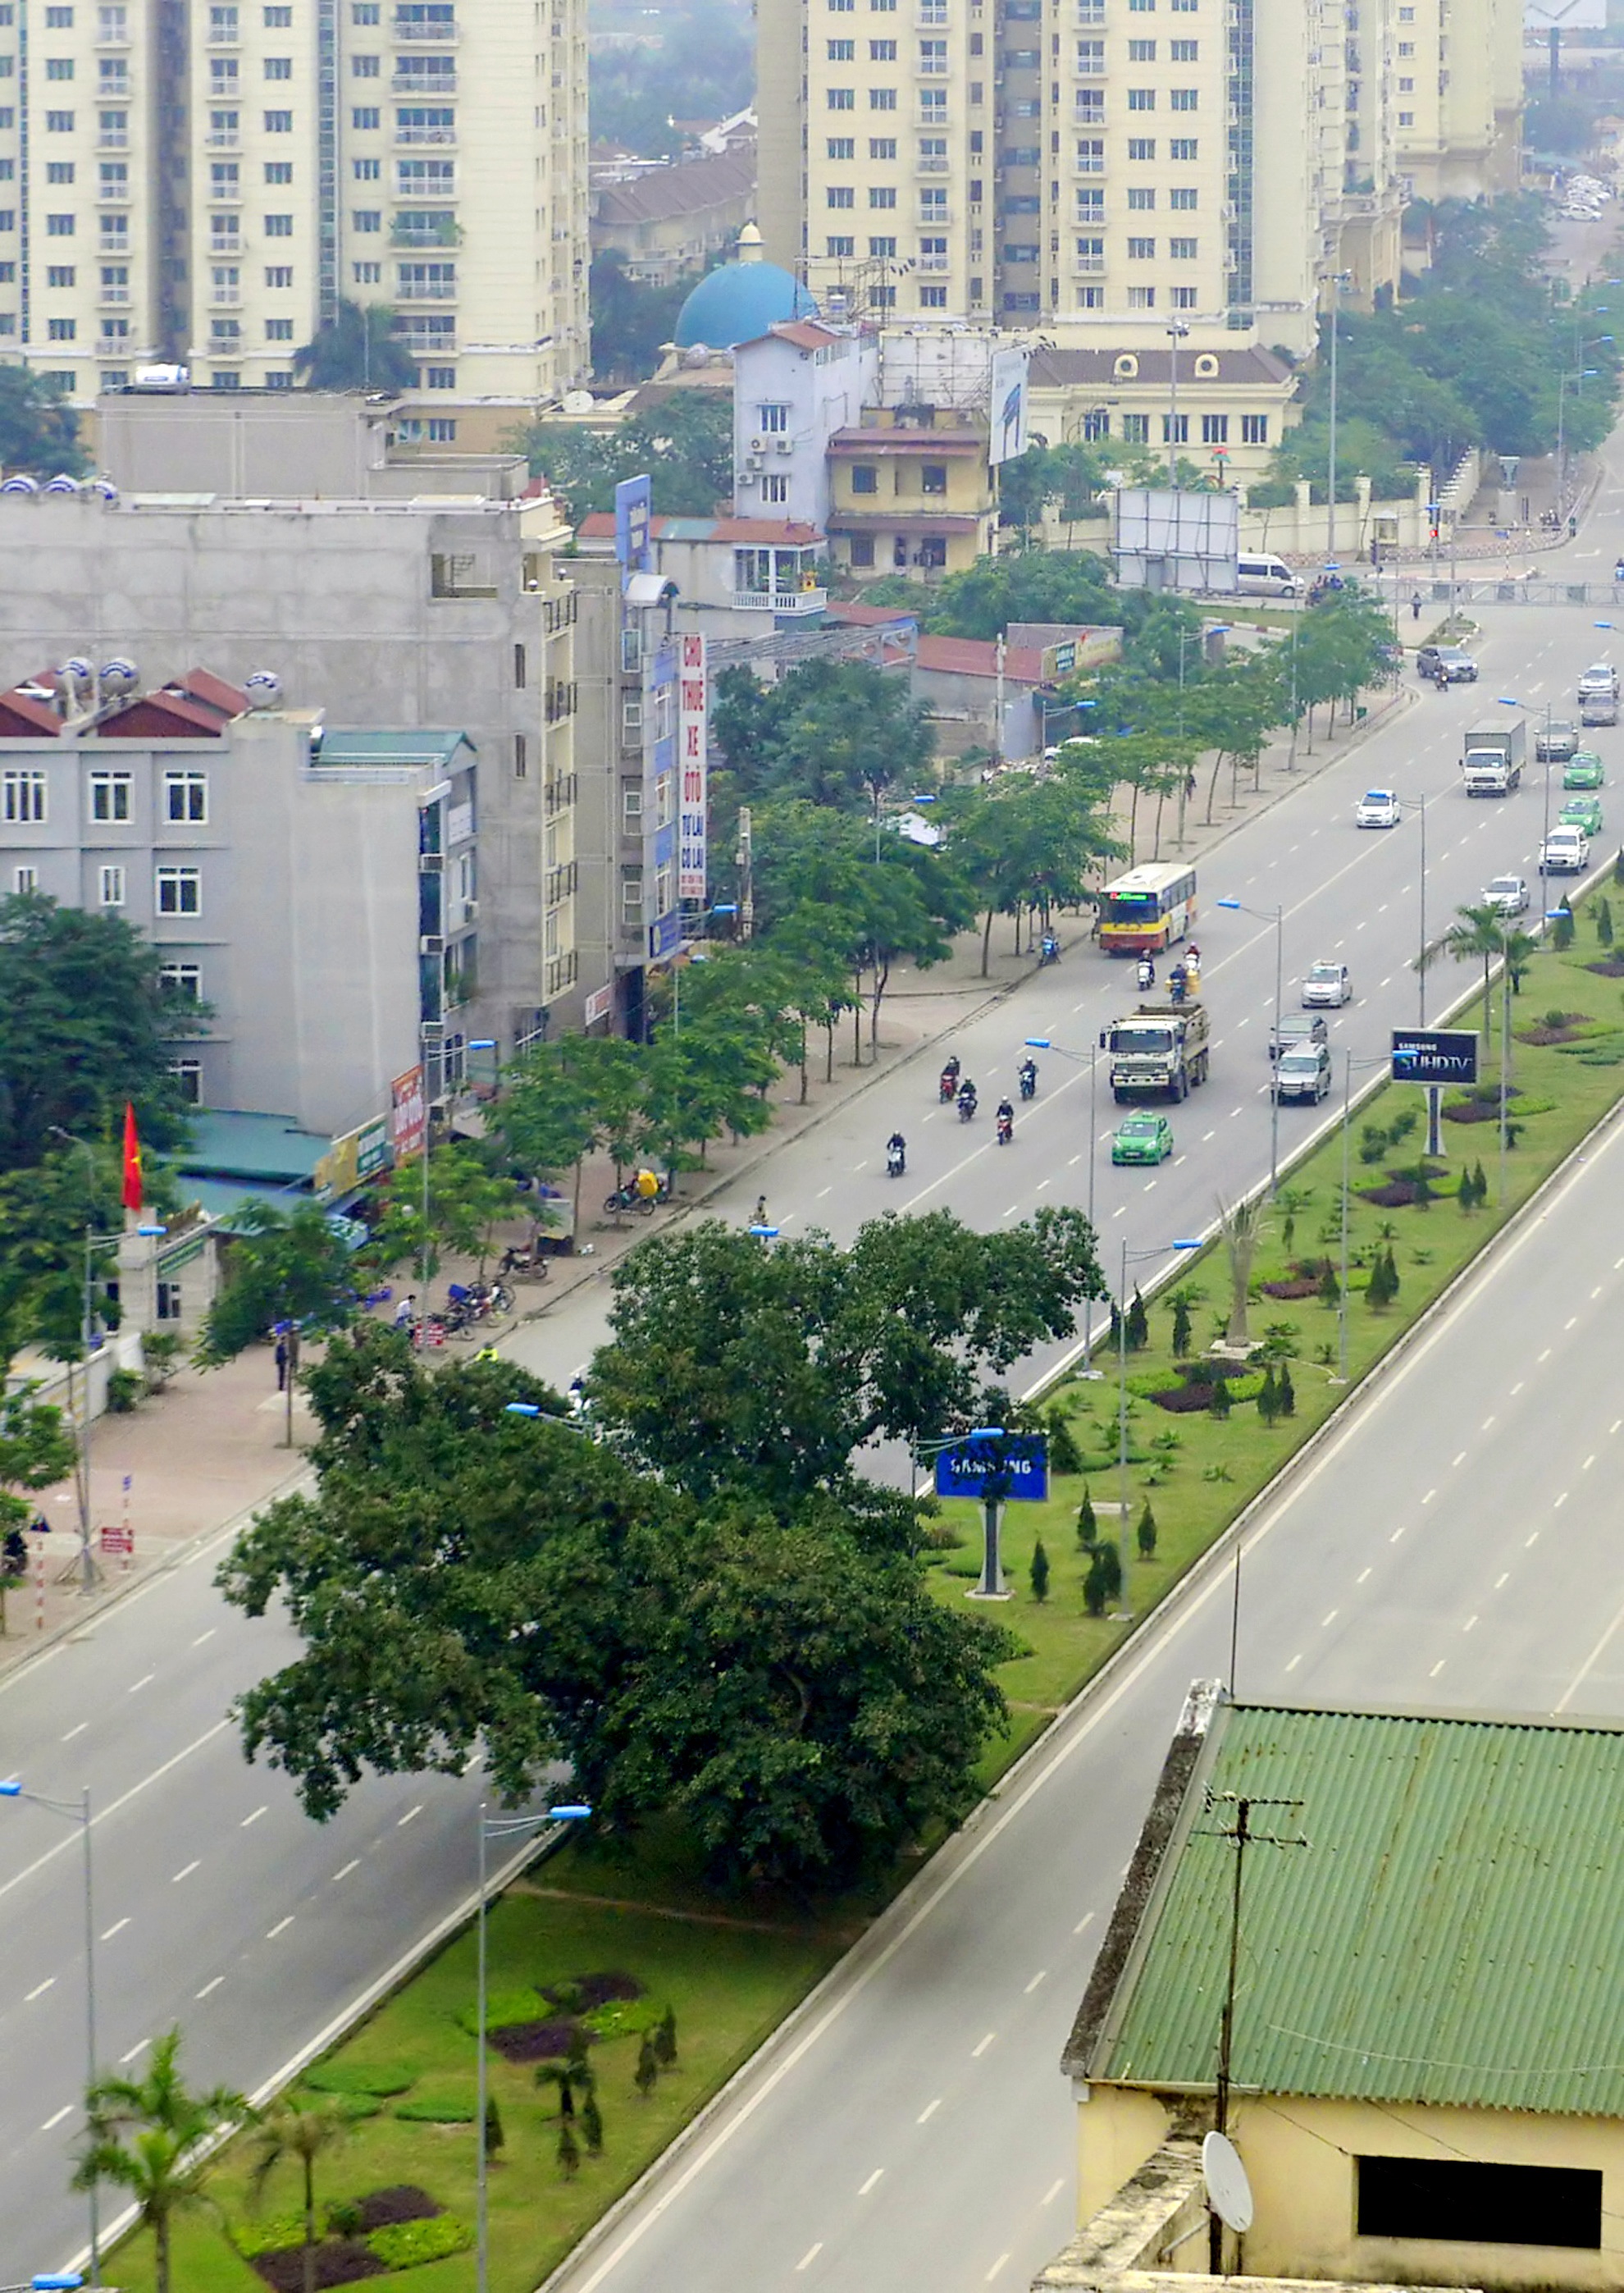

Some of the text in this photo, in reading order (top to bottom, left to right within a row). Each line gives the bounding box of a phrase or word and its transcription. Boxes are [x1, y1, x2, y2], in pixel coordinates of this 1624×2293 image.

[684, 636, 701, 667] CHO
[687, 725, 698, 756] XE
[1398, 1043, 1437, 1051] SAMSUNG
